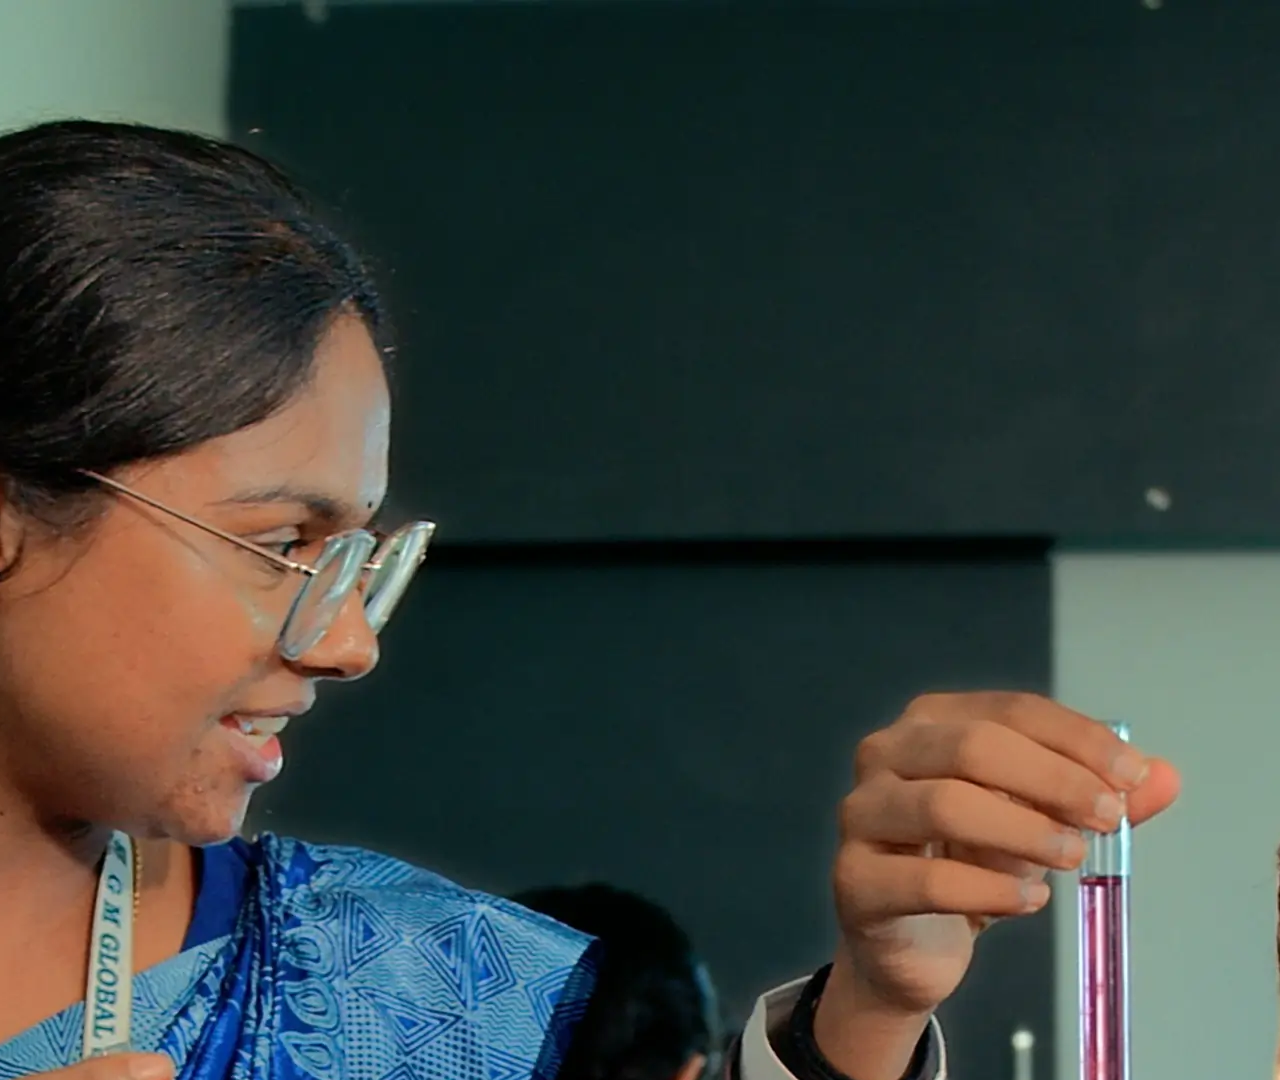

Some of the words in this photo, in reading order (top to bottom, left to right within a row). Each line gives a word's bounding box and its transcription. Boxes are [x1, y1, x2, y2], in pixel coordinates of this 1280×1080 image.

[107, 874, 122, 894] G
[103, 901, 121, 928] M
[93, 933, 120, 1039] GLOBAL
